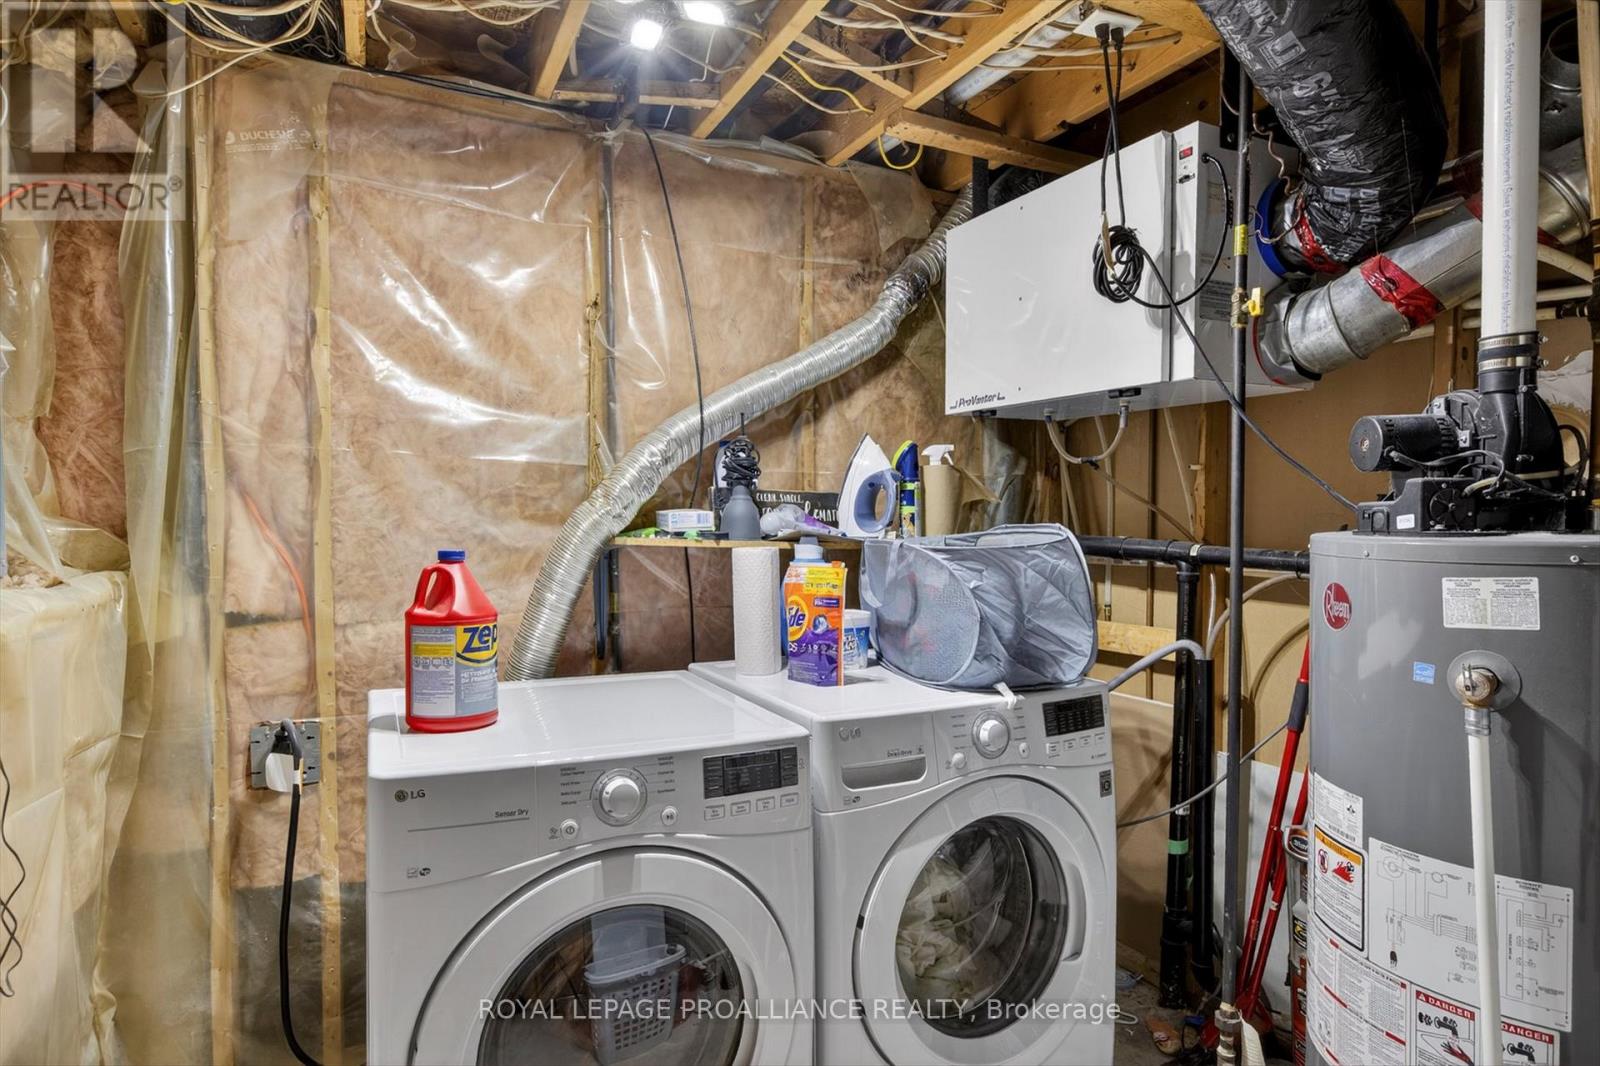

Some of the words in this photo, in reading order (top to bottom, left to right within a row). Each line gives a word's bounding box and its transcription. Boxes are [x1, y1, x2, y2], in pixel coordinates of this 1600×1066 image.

[1325, 583, 1350, 622] Rheem
[462, 624, 497, 654] Zep
[410, 789, 426, 799] LG
[494, 810, 516, 819] Sensor
[517, 808, 529, 817] Dry
[1428, 996, 1472, 1019] DANGER
